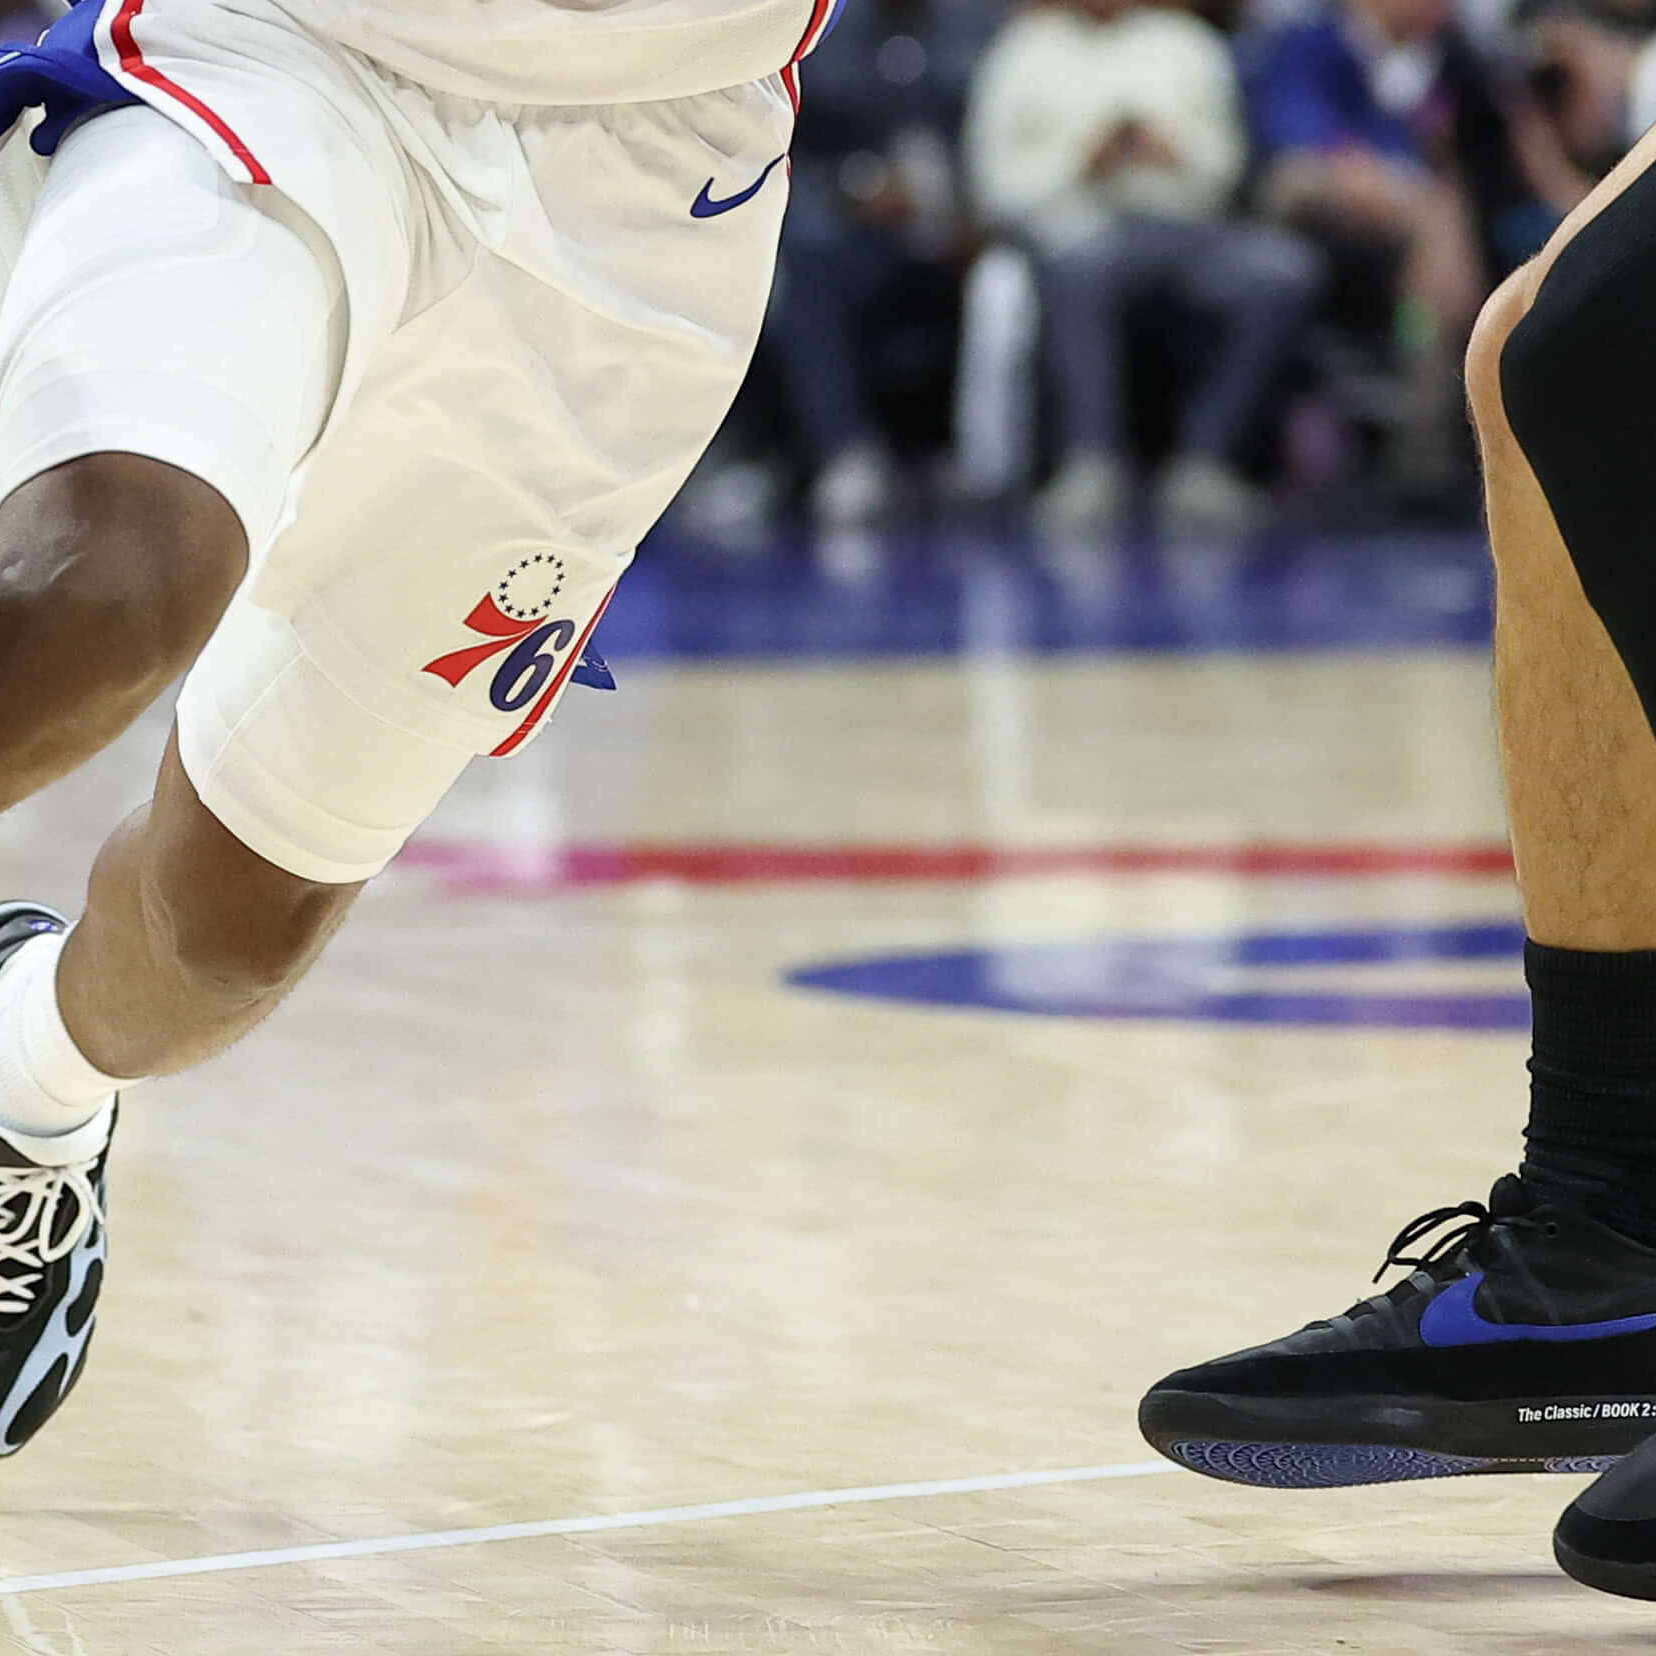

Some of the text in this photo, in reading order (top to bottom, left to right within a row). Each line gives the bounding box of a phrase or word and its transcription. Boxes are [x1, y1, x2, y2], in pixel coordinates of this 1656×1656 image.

[421, 592, 576, 713] 76
[1518, 1407, 1543, 1423] The
[1544, 1404, 1593, 1421] Classic
[1601, 1402, 1641, 1419] BOOK
